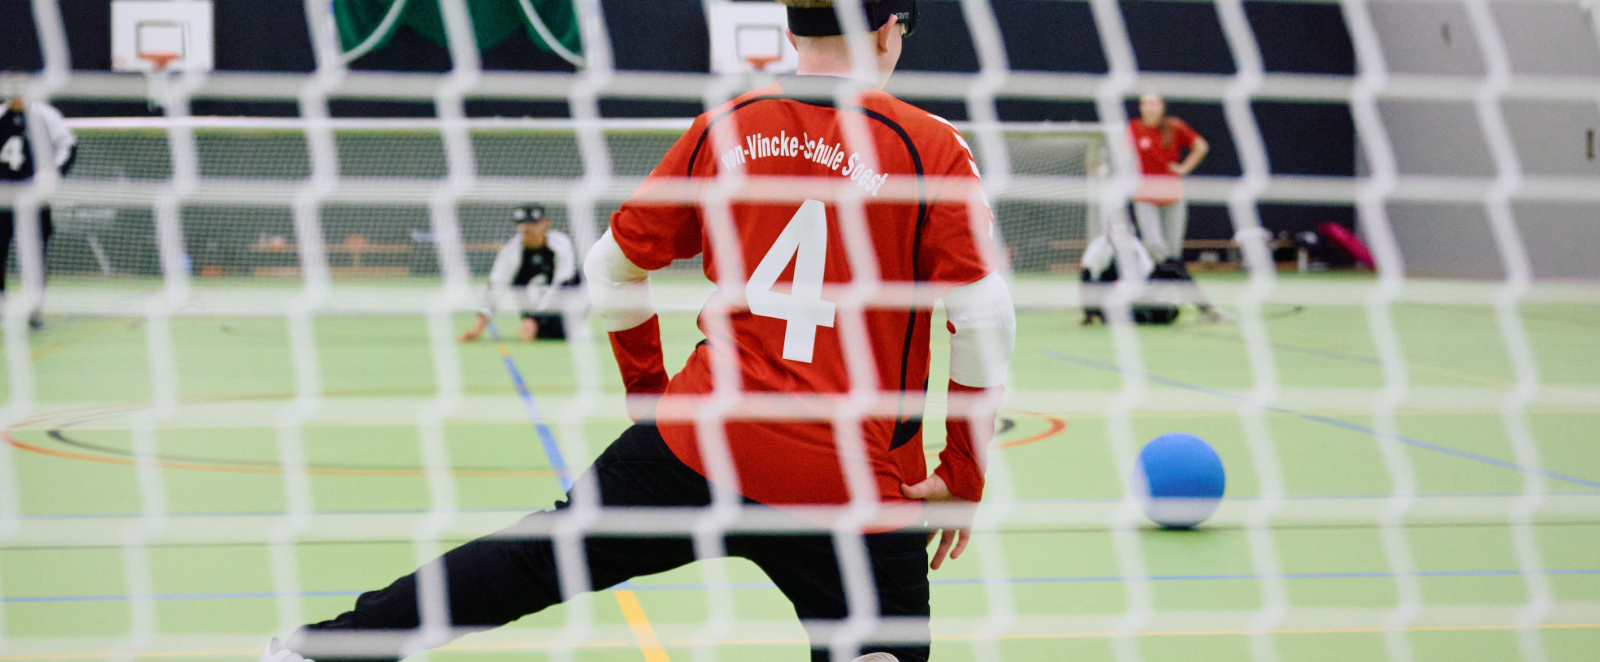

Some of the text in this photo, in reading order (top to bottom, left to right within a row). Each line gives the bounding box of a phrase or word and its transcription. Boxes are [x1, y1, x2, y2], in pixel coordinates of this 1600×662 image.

[0, 135, 25, 171] 4
[842, 152, 889, 196] Soest
[745, 199, 836, 363] 4
